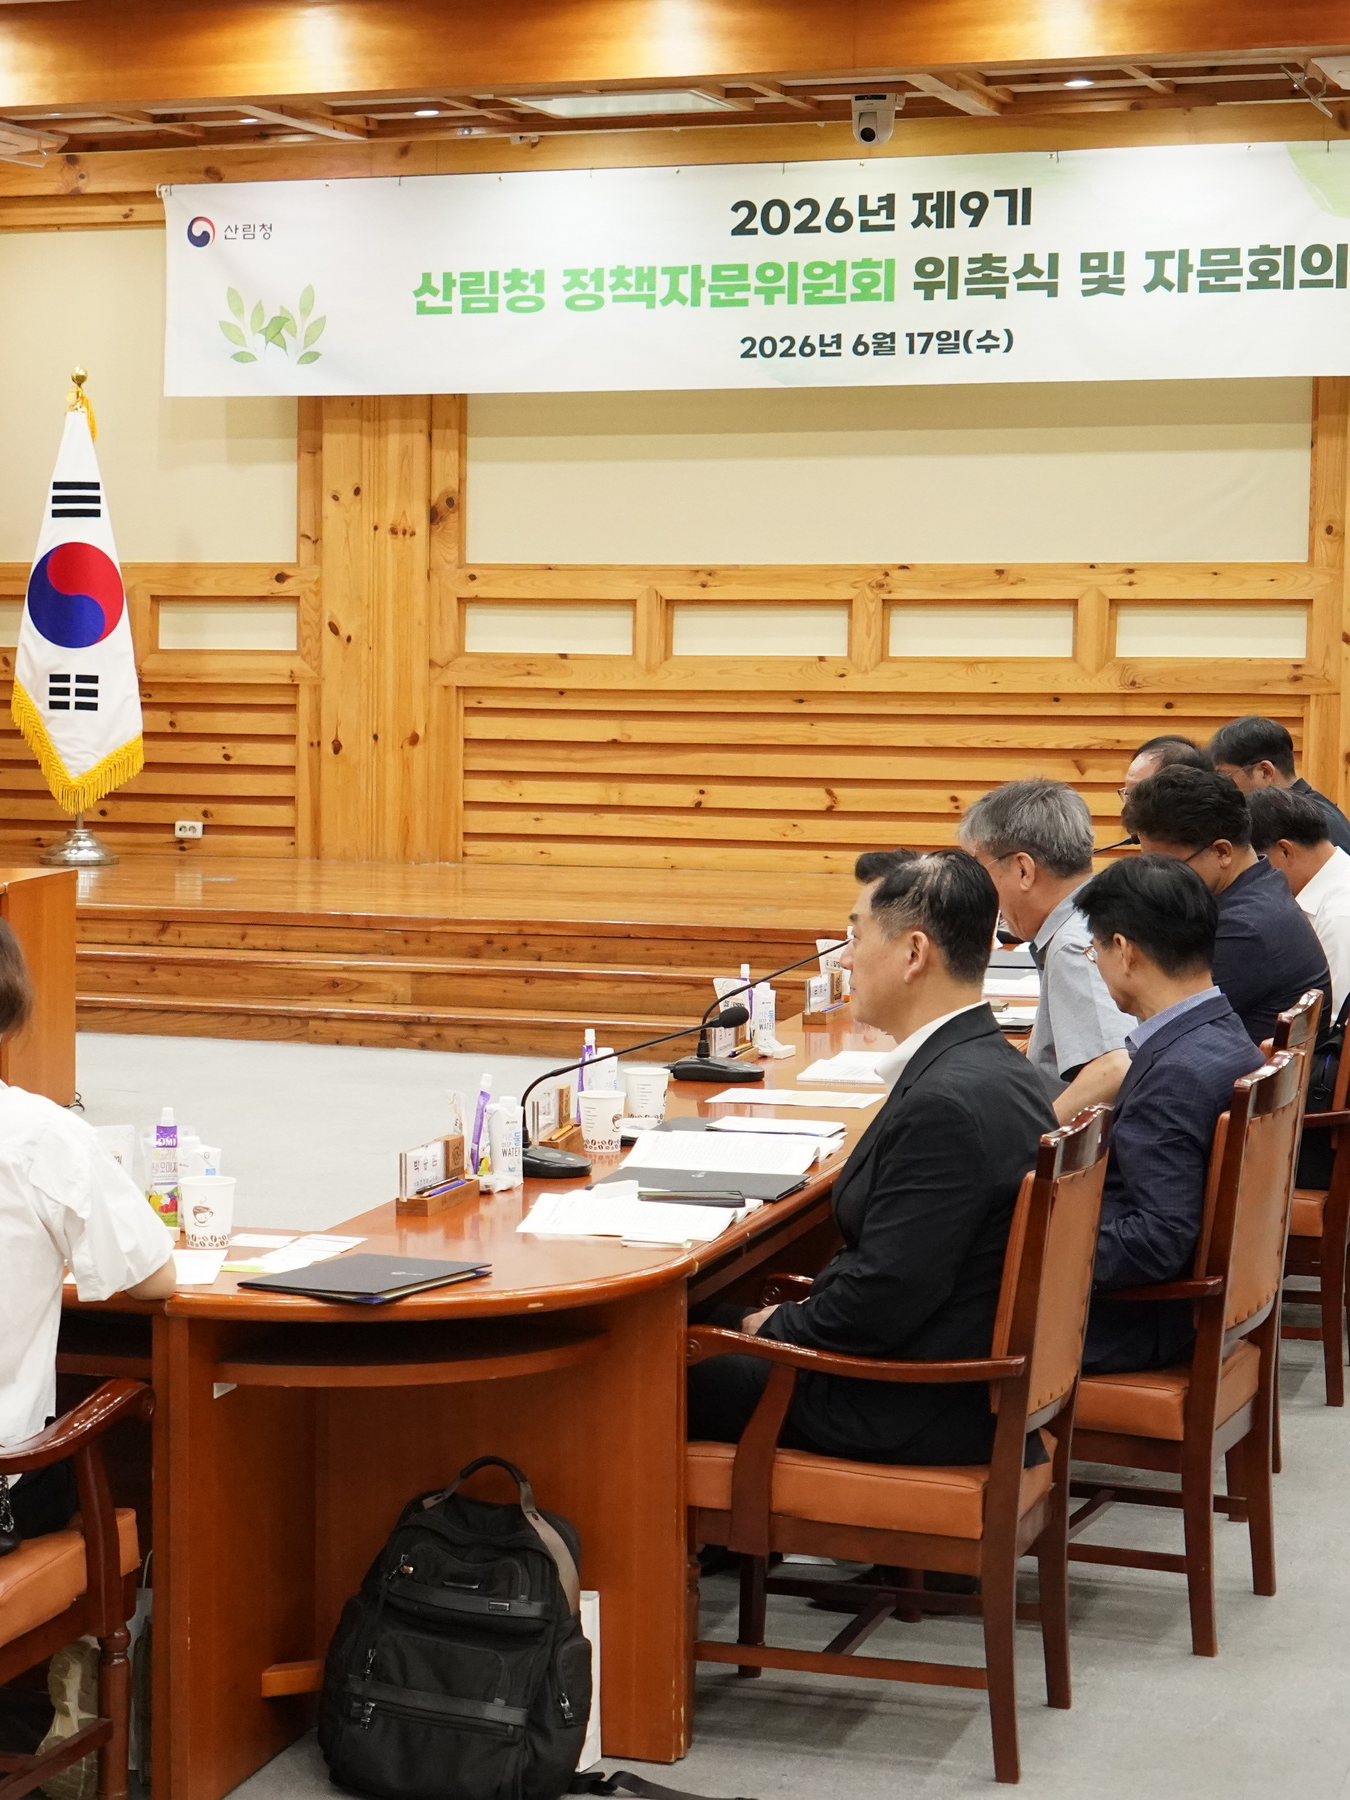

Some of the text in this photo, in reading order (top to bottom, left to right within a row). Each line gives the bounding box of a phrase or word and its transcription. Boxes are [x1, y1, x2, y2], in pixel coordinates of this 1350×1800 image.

[224, 223, 273, 240] 산림청
[730, 187, 1032, 237] 2026년 제9기
[412, 243, 1349, 315] 산림청 정책자문위원회 위촉식 및 자문회의
[740, 328, 1014, 359] 2026년 6월 17일(수)
